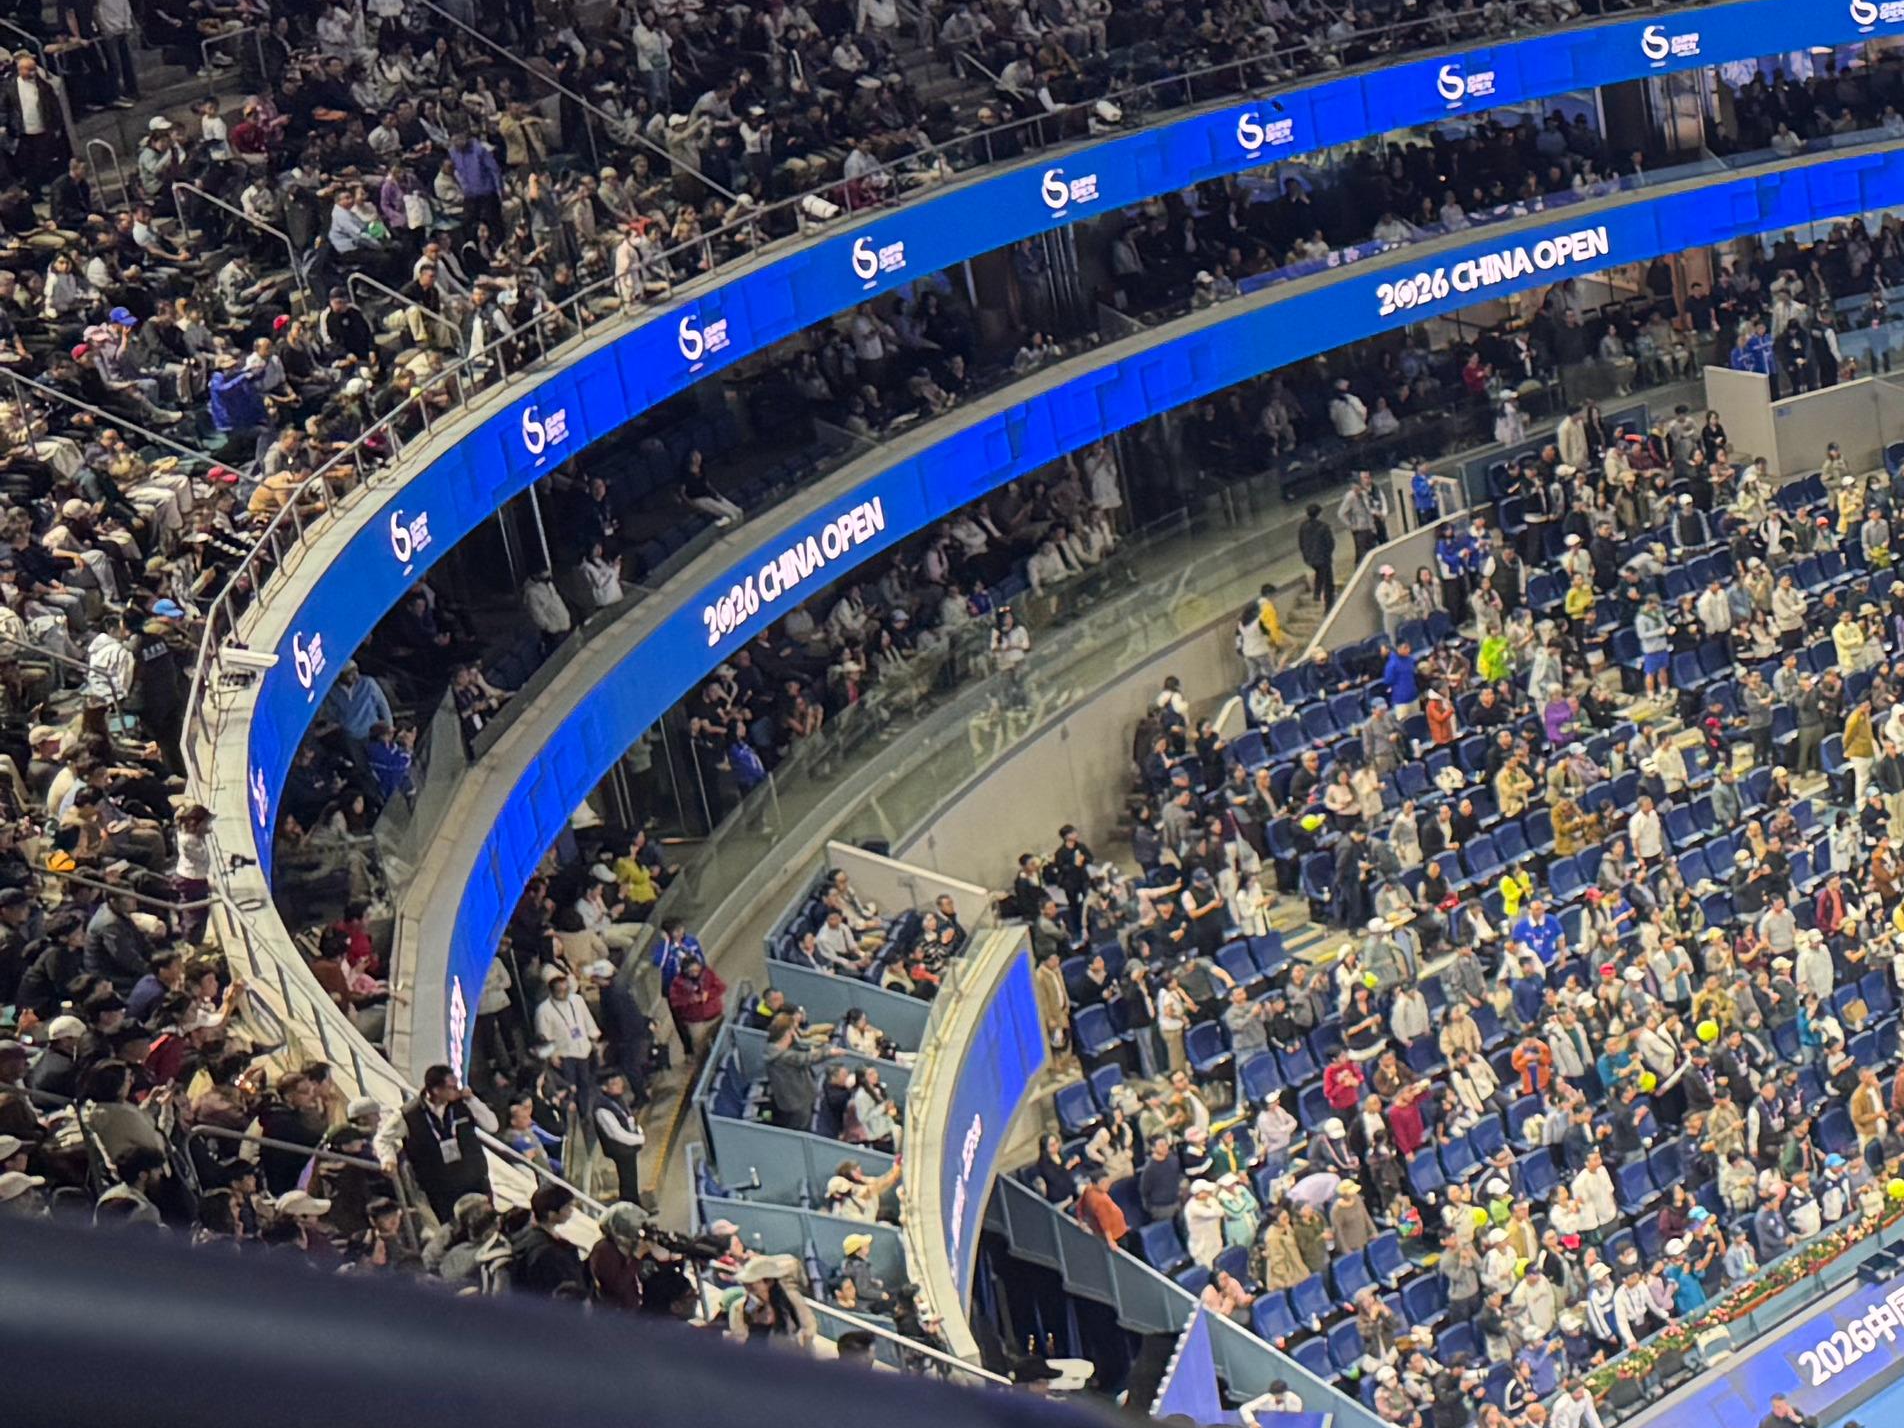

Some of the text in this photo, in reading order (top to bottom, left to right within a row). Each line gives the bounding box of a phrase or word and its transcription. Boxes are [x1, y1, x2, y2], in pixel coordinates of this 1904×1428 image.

[1451, 246, 1535, 293] CHINA
[1533, 226, 1609, 269] OPEN
[759, 535, 826, 603] CHINA
[822, 495, 885, 560] OPEN
